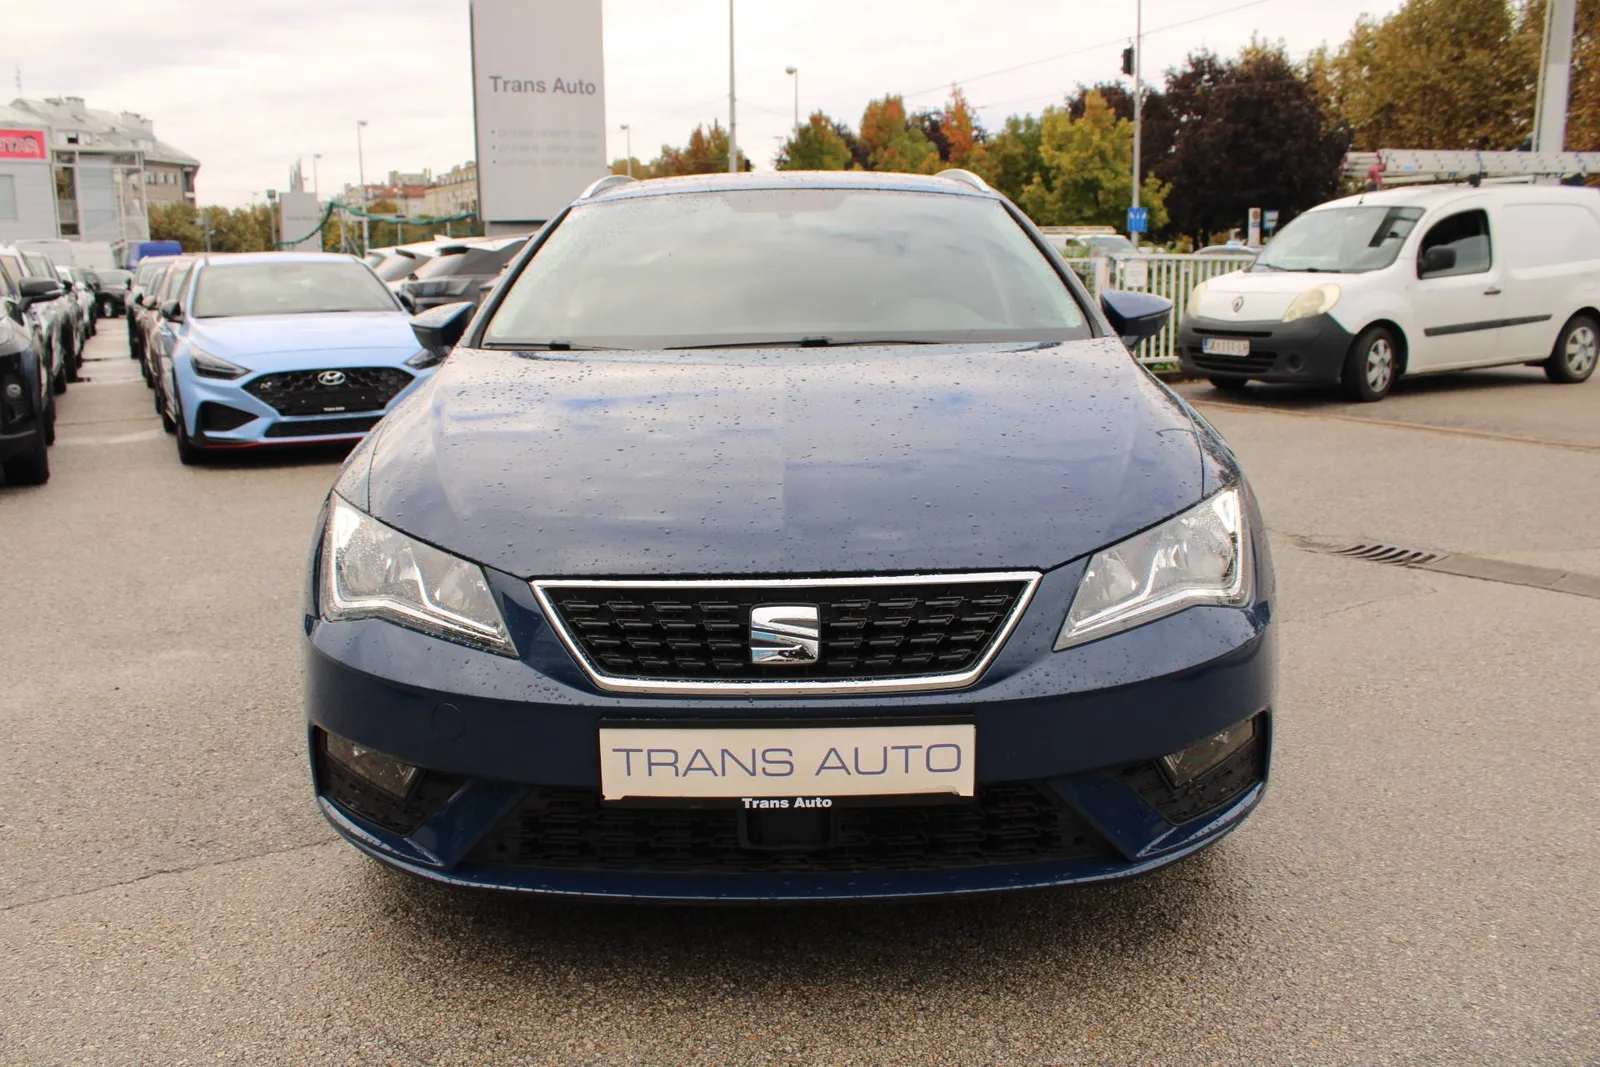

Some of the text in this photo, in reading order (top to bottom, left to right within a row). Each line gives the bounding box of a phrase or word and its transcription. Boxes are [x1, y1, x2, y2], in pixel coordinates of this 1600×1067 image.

[488, 75, 596, 95] Trans Auto
[612, 743, 962, 778] TRANS AUTO
[742, 797, 833, 809] Trans Auto
